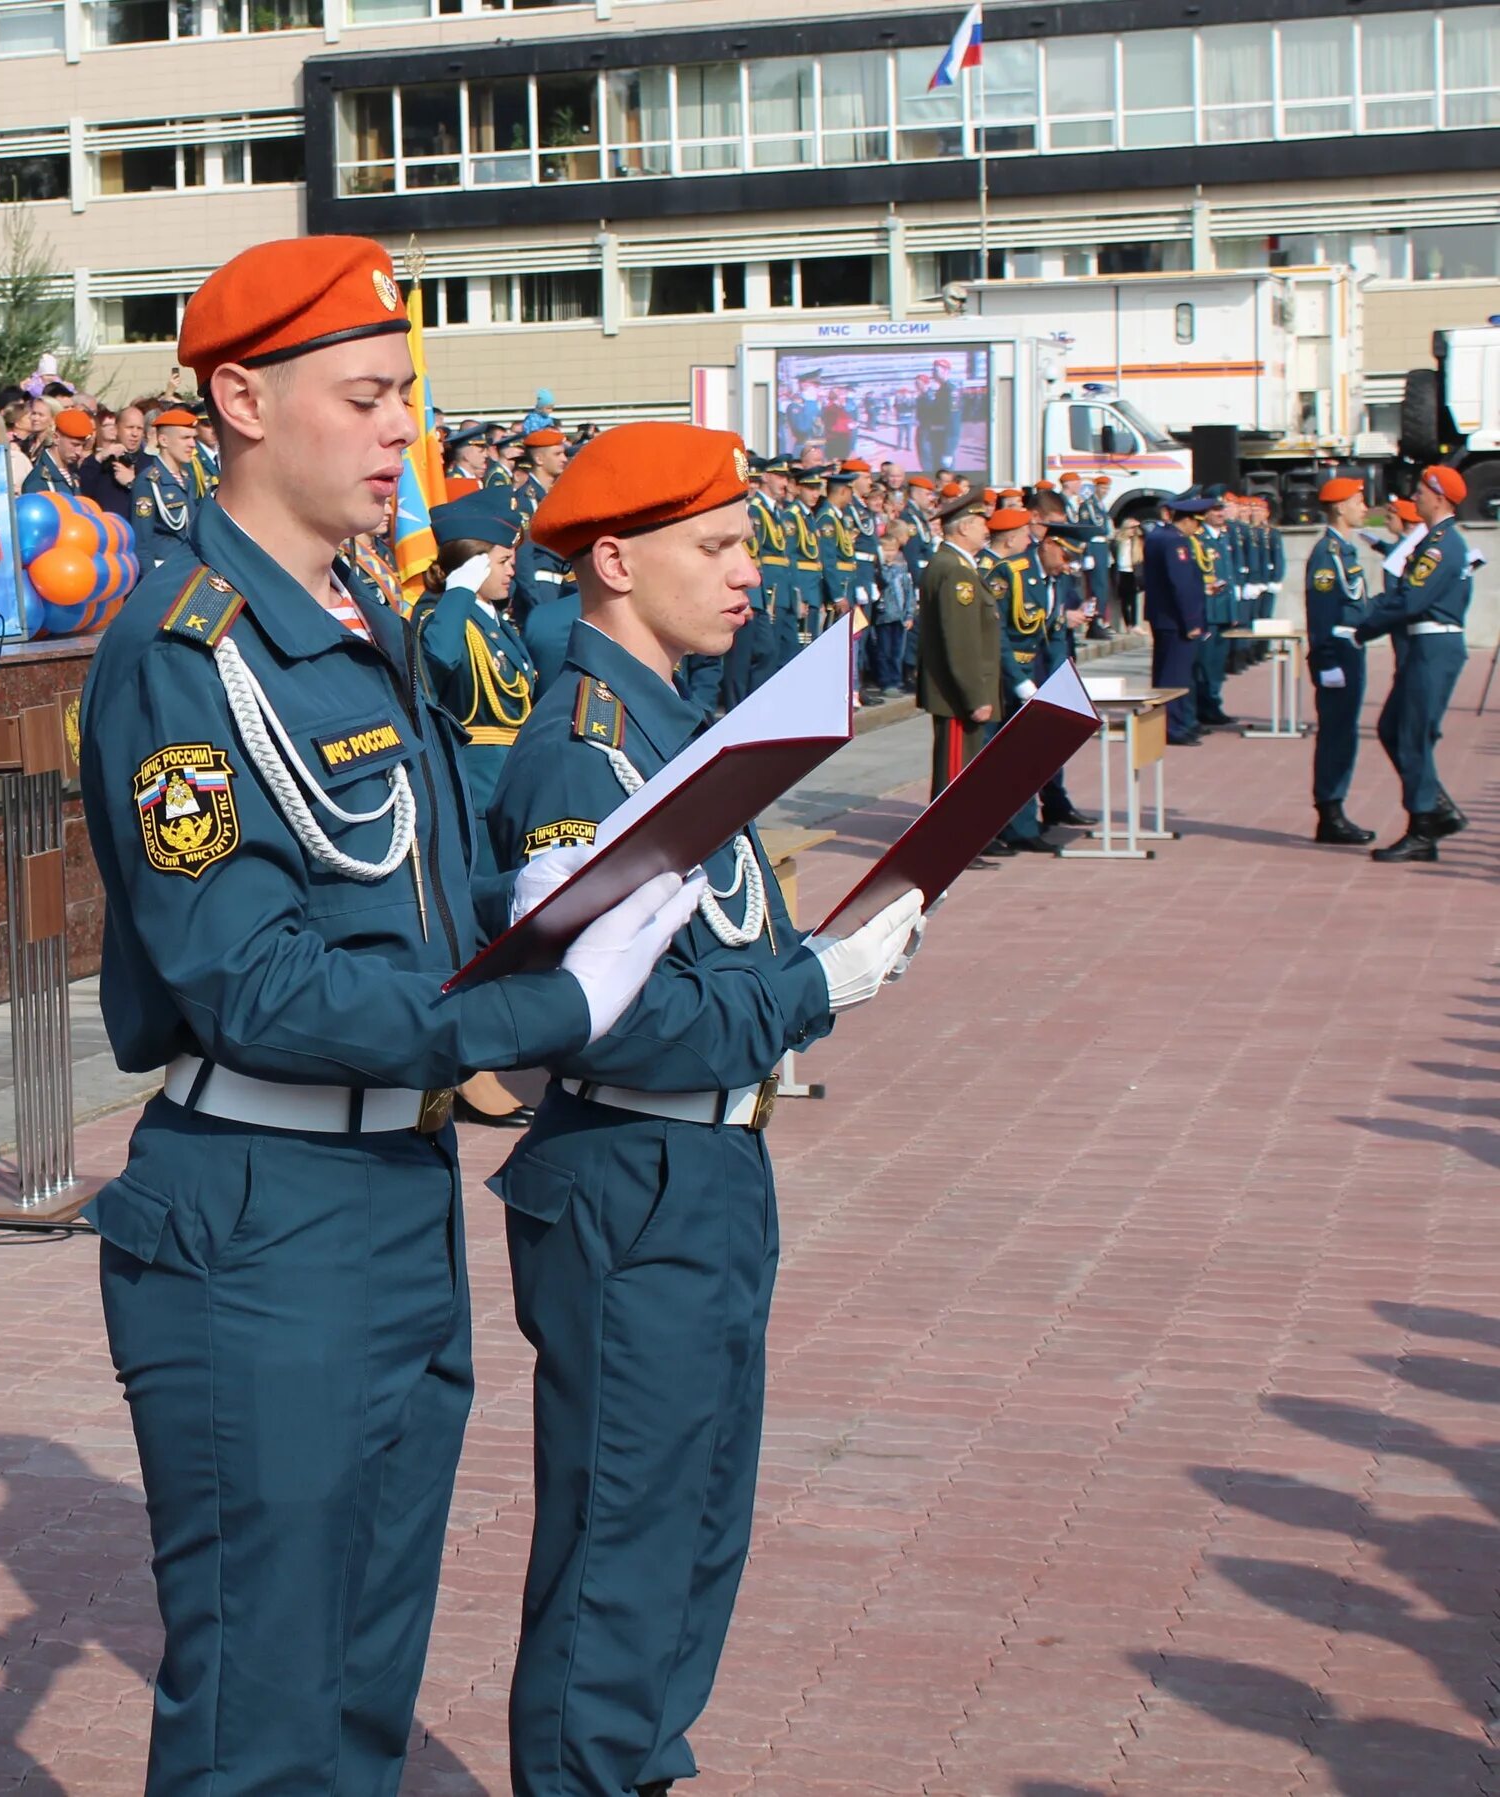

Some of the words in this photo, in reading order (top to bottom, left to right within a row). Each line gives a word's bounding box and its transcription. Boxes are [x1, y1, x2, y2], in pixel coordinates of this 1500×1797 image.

[818, 325, 851, 336] МЧС
[868, 323, 930, 335] РОССИИ
[322, 740, 352, 765] МЧС
[348, 725, 401, 757] РОССИИ
[143, 757, 161, 780] МЧС
[162, 749, 208, 767] РОССИИ
[143, 813, 180, 866] УРАЛЬСКИЙ
[185, 822, 232, 863] ИНСТИТУТ
[217, 793, 231, 818] ГПС
[538, 826, 559, 841] МЧС
